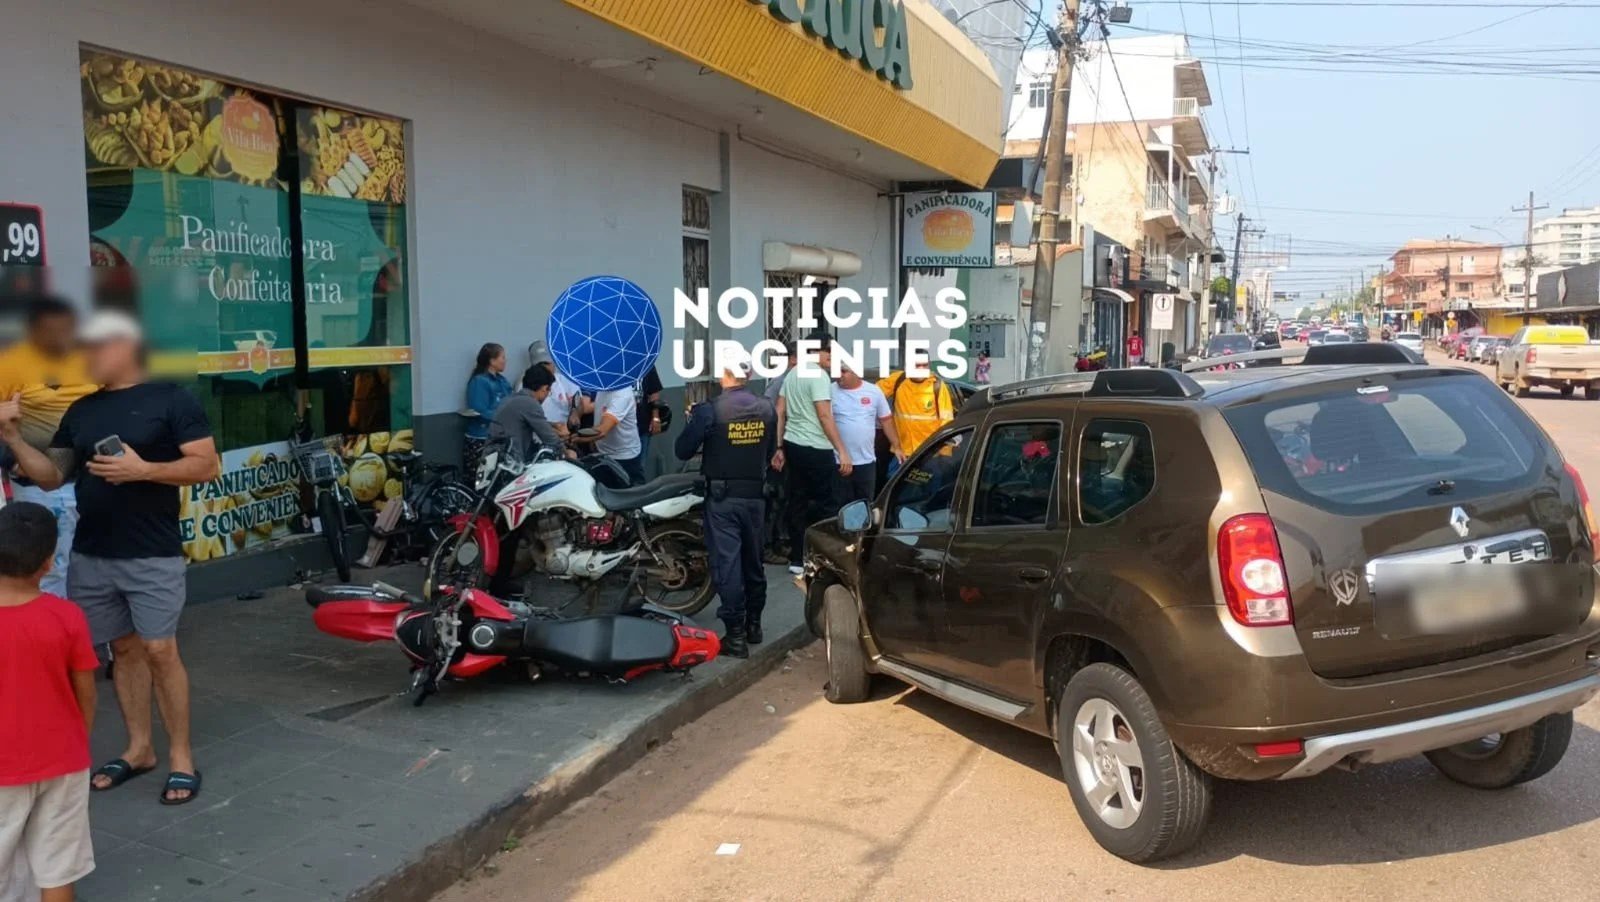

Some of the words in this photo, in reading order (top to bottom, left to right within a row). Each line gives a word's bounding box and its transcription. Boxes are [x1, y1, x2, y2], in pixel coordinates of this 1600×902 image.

[906, 194, 991, 218] PANIFICADORA
[906, 256, 912, 265] E
[915, 254, 989, 265] CONVENIÊNCIA
[208, 265, 343, 304] Confeitaria
[729, 420, 765, 430] POLÍCIA
[728, 430, 764, 439] MILITAR
[190, 456, 346, 502] PANIFICADOA
[180, 518, 196, 542] E
[202, 490, 300, 538] CONVENIÊN
[1312, 626, 1360, 639] RENAULT
